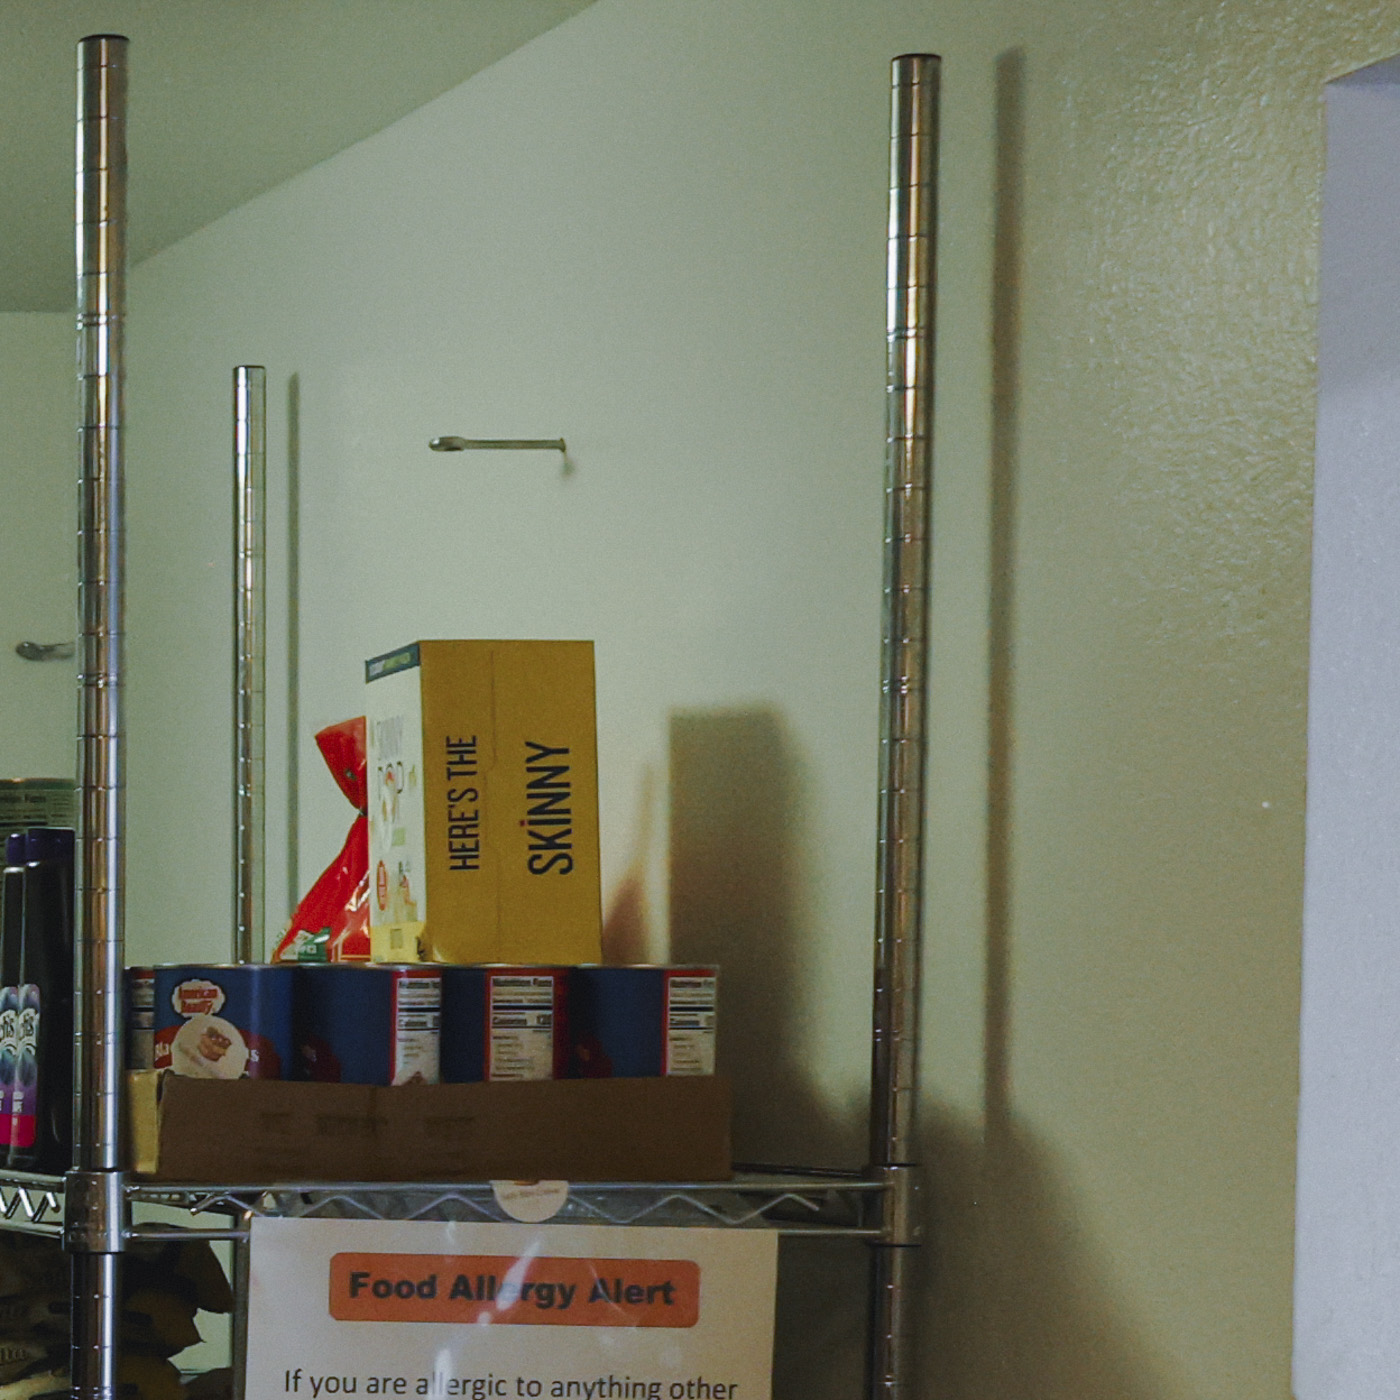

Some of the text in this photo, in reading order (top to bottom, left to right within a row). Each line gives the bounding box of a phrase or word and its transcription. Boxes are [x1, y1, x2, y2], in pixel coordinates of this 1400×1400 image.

[446, 735, 480, 870] HERE'S THE
[523, 741, 574, 875] SKINNY
[349, 1271, 676, 1310] Food Allergy Alert
[285, 1368, 302, 1392] If
[310, 1376, 357, 1399] you
[366, 1377, 407, 1394] are
[516, 1377, 542, 1397] to
[670, 1376, 738, 1400] other
